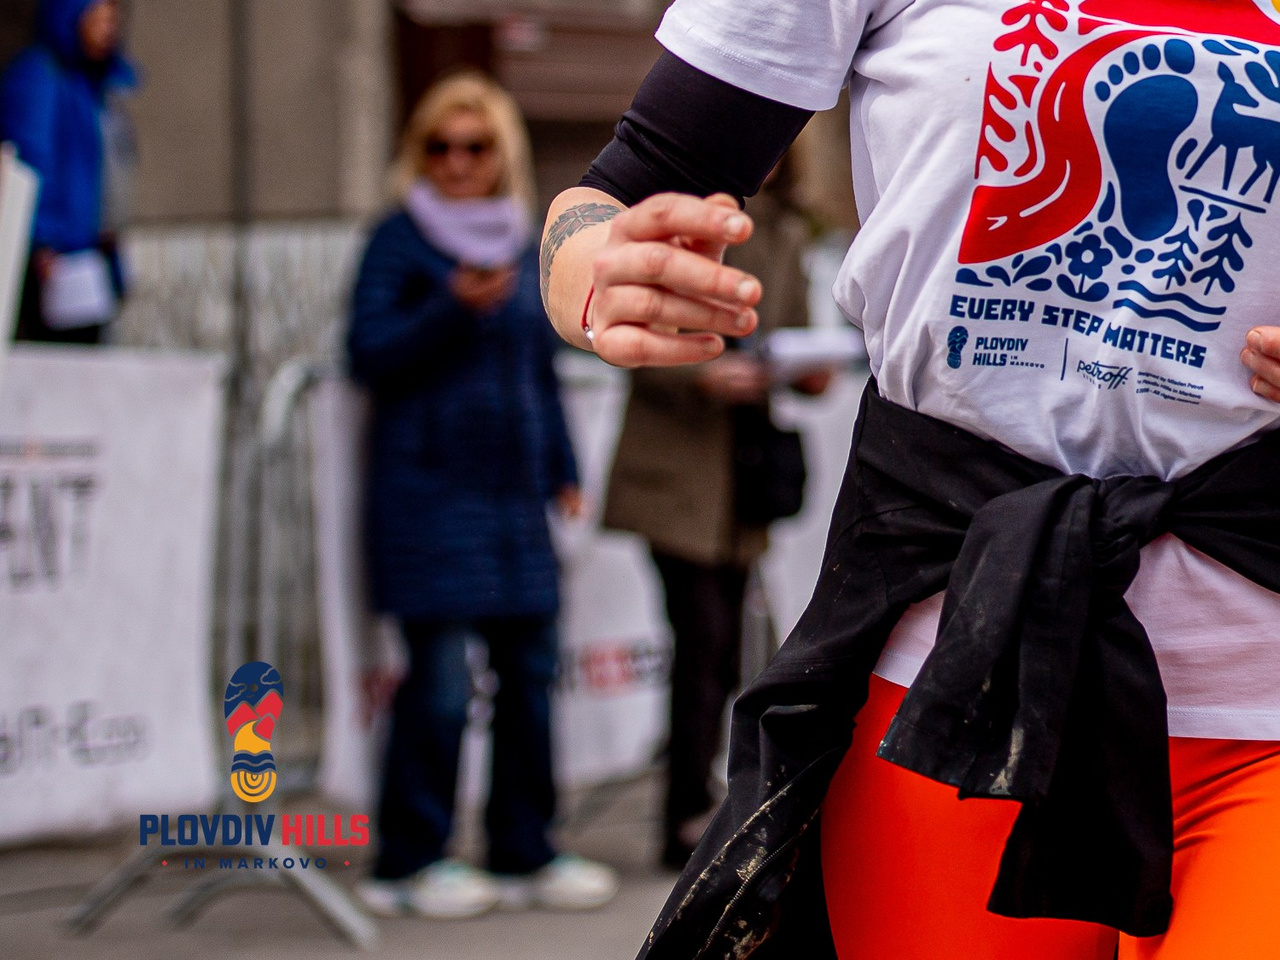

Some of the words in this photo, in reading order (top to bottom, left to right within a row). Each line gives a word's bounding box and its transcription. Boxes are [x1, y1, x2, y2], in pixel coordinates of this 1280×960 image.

[949, 294, 1035, 322] EVERY
[1041, 304, 1104, 337] STEP
[1102, 322, 1207, 368] MATTERS
[975, 336, 1029, 351] PLOVDIV
[972, 353, 1008, 366] HILLS
[1009, 361, 1045, 369] MARKOVO
